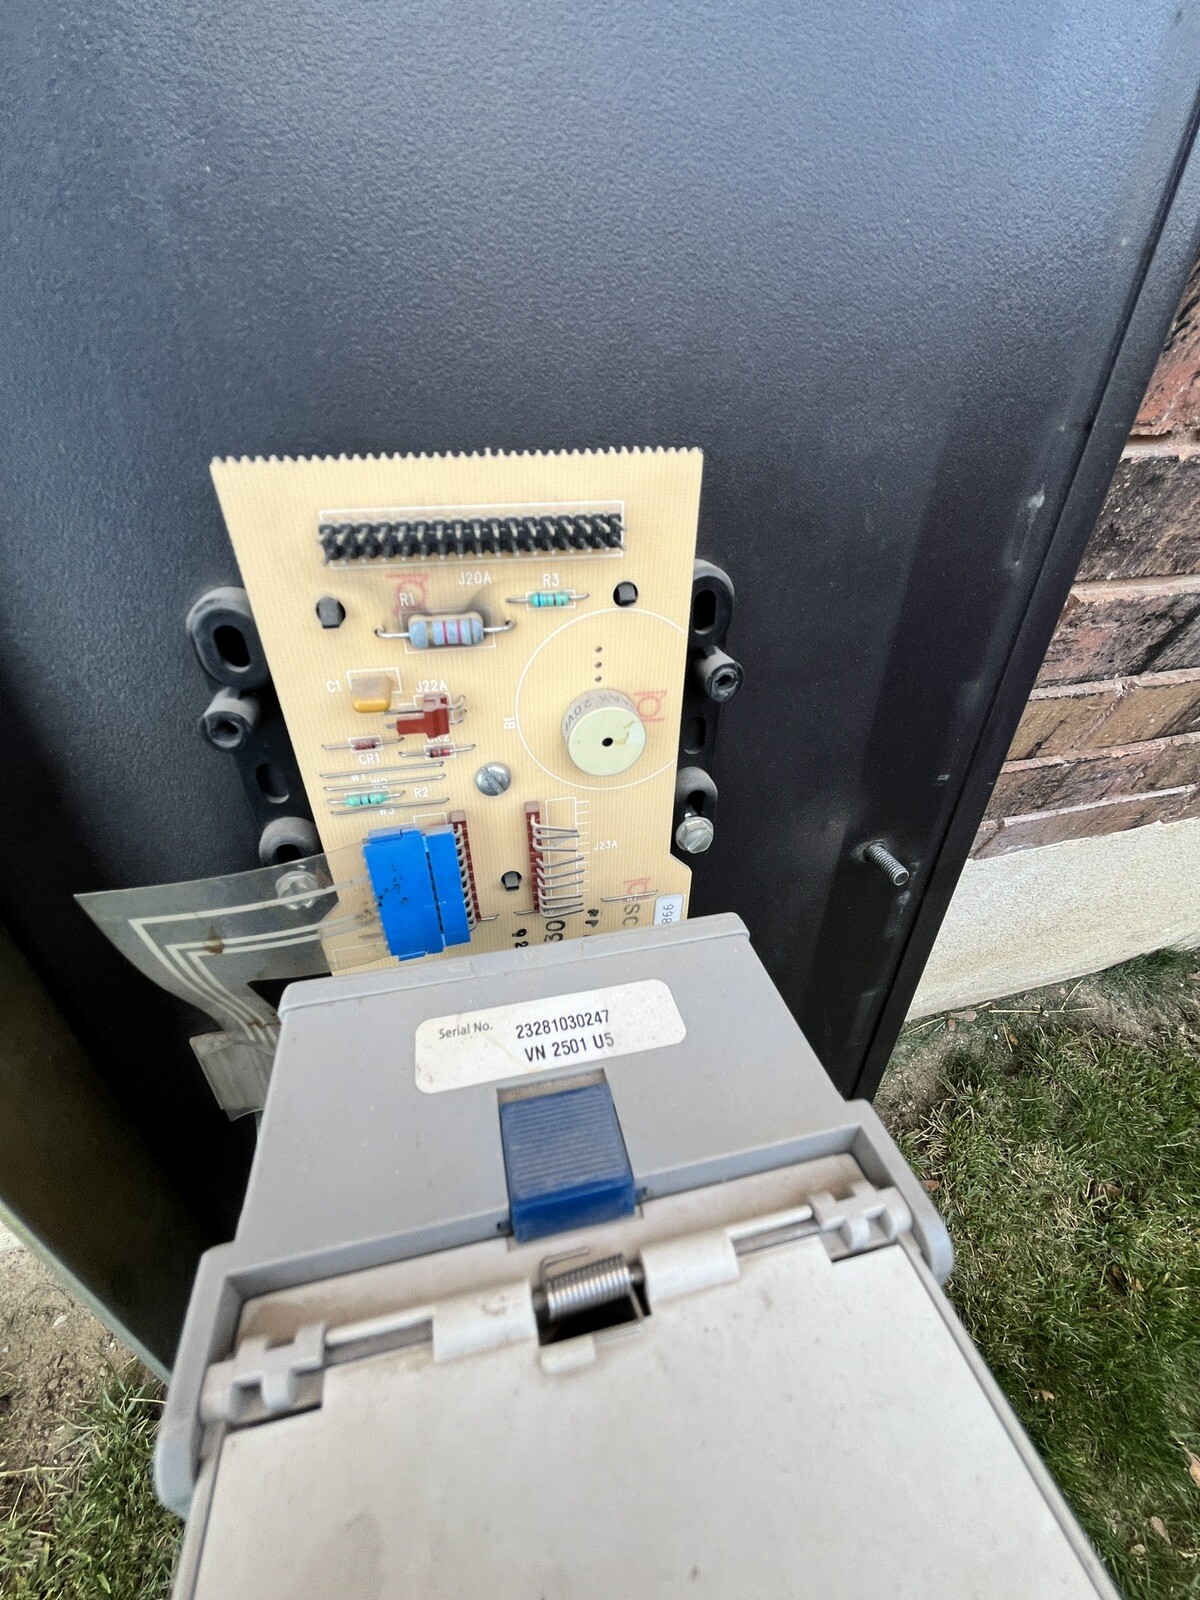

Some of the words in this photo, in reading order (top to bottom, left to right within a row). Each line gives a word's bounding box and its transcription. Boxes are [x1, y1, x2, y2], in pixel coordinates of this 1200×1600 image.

[458, 571, 492, 586] J20A
[542, 573, 560, 588] R3
[399, 592, 415, 607] R1
[325, 680, 342, 693] C1
[415, 679, 449, 693] J22A
[358, 754, 381, 766] CR1
[413, 787, 430, 798] R2
[593, 840, 618, 851] J23A
[438, 1024, 471, 1040] Serial
[473, 1022, 493, 1034] No.
[515, 1009, 610, 1039] 23281030247
[524, 1044, 547, 1063] VN
[551, 1037, 588, 1058] 2501
[592, 1031, 615, 1050] U5
